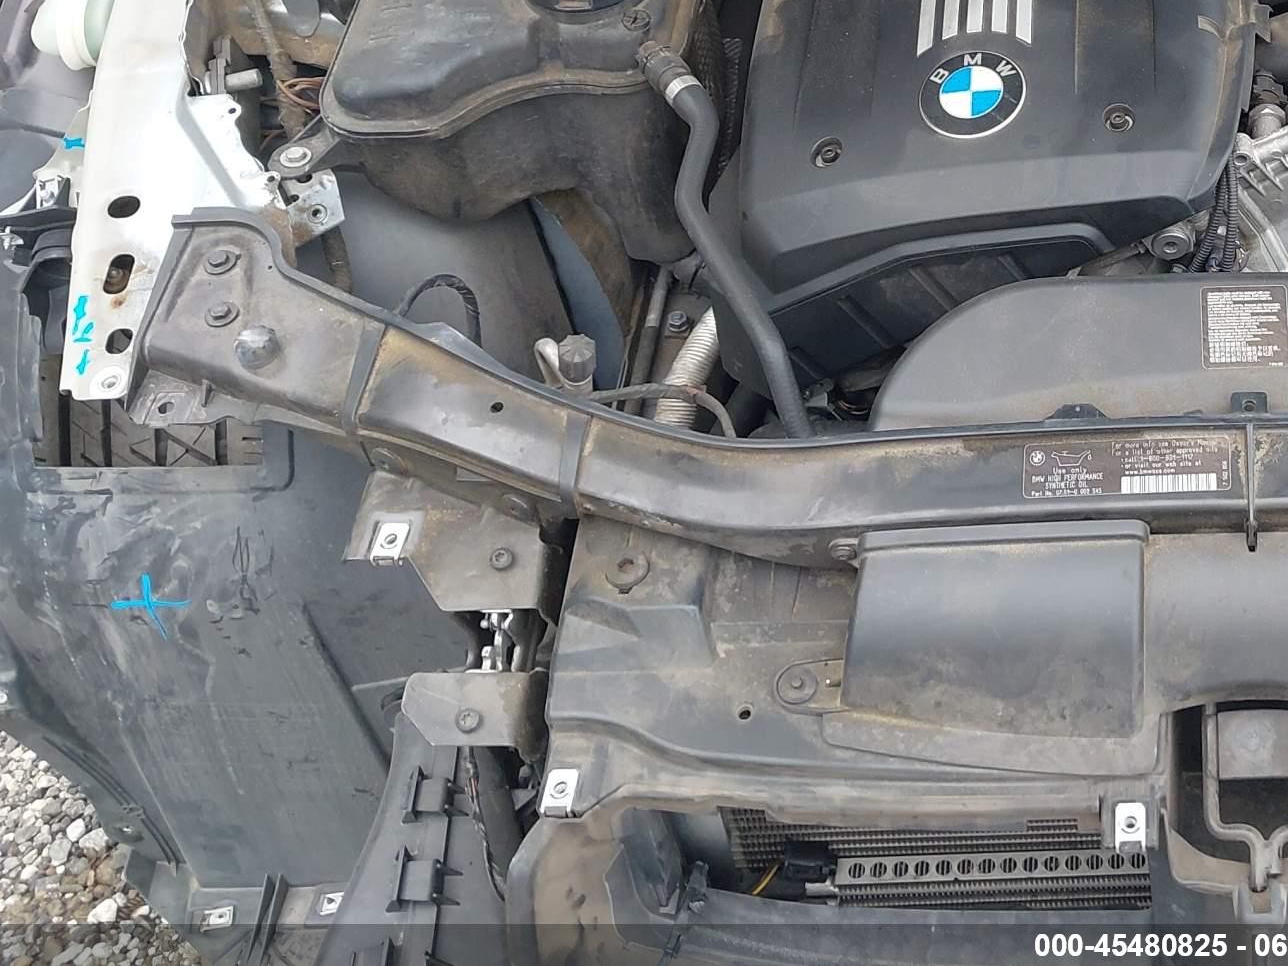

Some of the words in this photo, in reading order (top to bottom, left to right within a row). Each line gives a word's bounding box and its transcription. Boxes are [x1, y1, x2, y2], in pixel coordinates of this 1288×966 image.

[930, 53, 1017, 84] BMW
[1175, 445, 1203, 454] approved
[1052, 466, 1067, 475] Use
[1070, 466, 1087, 475] only
[1031, 475, 1046, 483] BMW
[1047, 474, 1062, 482] HIGH
[1063, 472, 1104, 481] PERFORMANCE
[1045, 481, 1076, 489] SYNTHETIC
[1078, 480, 1089, 488] OIL
